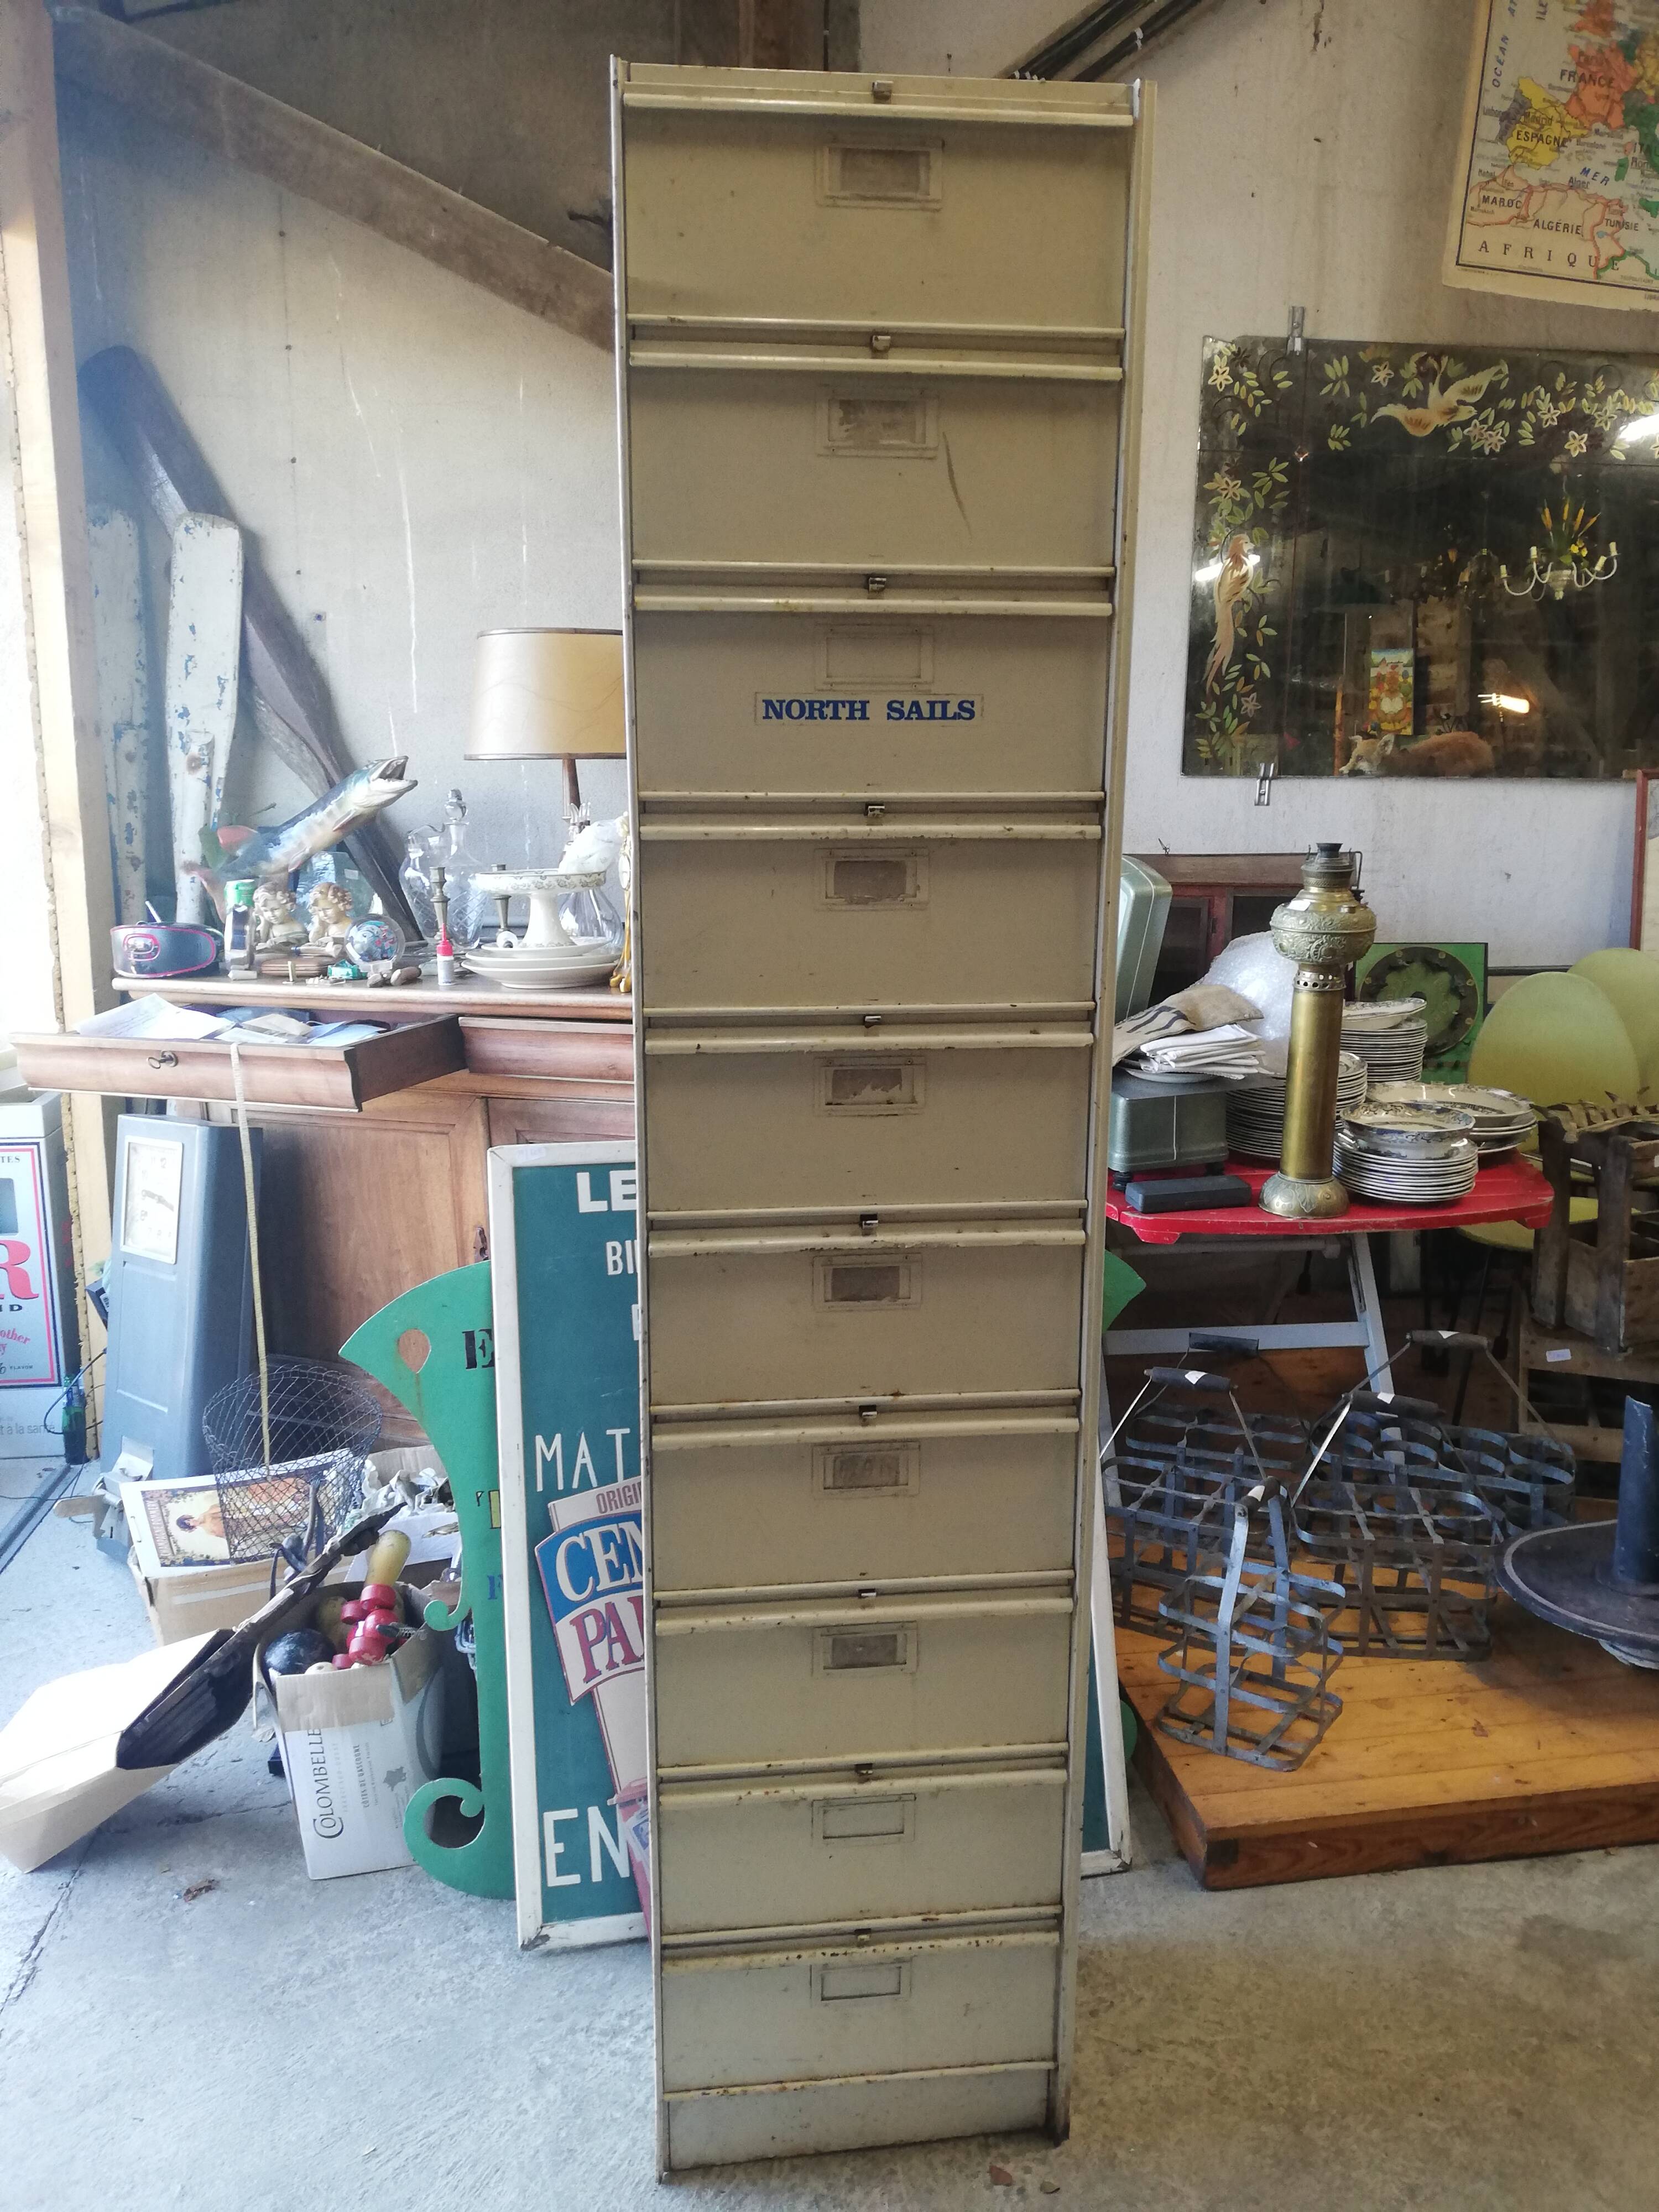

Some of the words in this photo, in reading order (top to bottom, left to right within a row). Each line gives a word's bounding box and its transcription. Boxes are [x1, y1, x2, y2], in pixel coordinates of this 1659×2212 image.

[1560, 69, 1615, 89] FRANCE
[1516, 130, 1568, 148] ESPAGNE
[1568, 176, 1590, 190] Alger
[1580, 167, 1610, 186] MER
[1482, 195, 1523, 210] MAROC
[1605, 218, 1639, 231] TUNISIE
[1478, 241, 1619, 270] AFRIQUE
[762, 699, 870, 720] NORTH
[886, 700, 975, 721] SAILS
[576, 1170, 637, 1213] LE
[535, 1428, 630, 1492] MAT
[543, 1806, 630, 1887] EN
